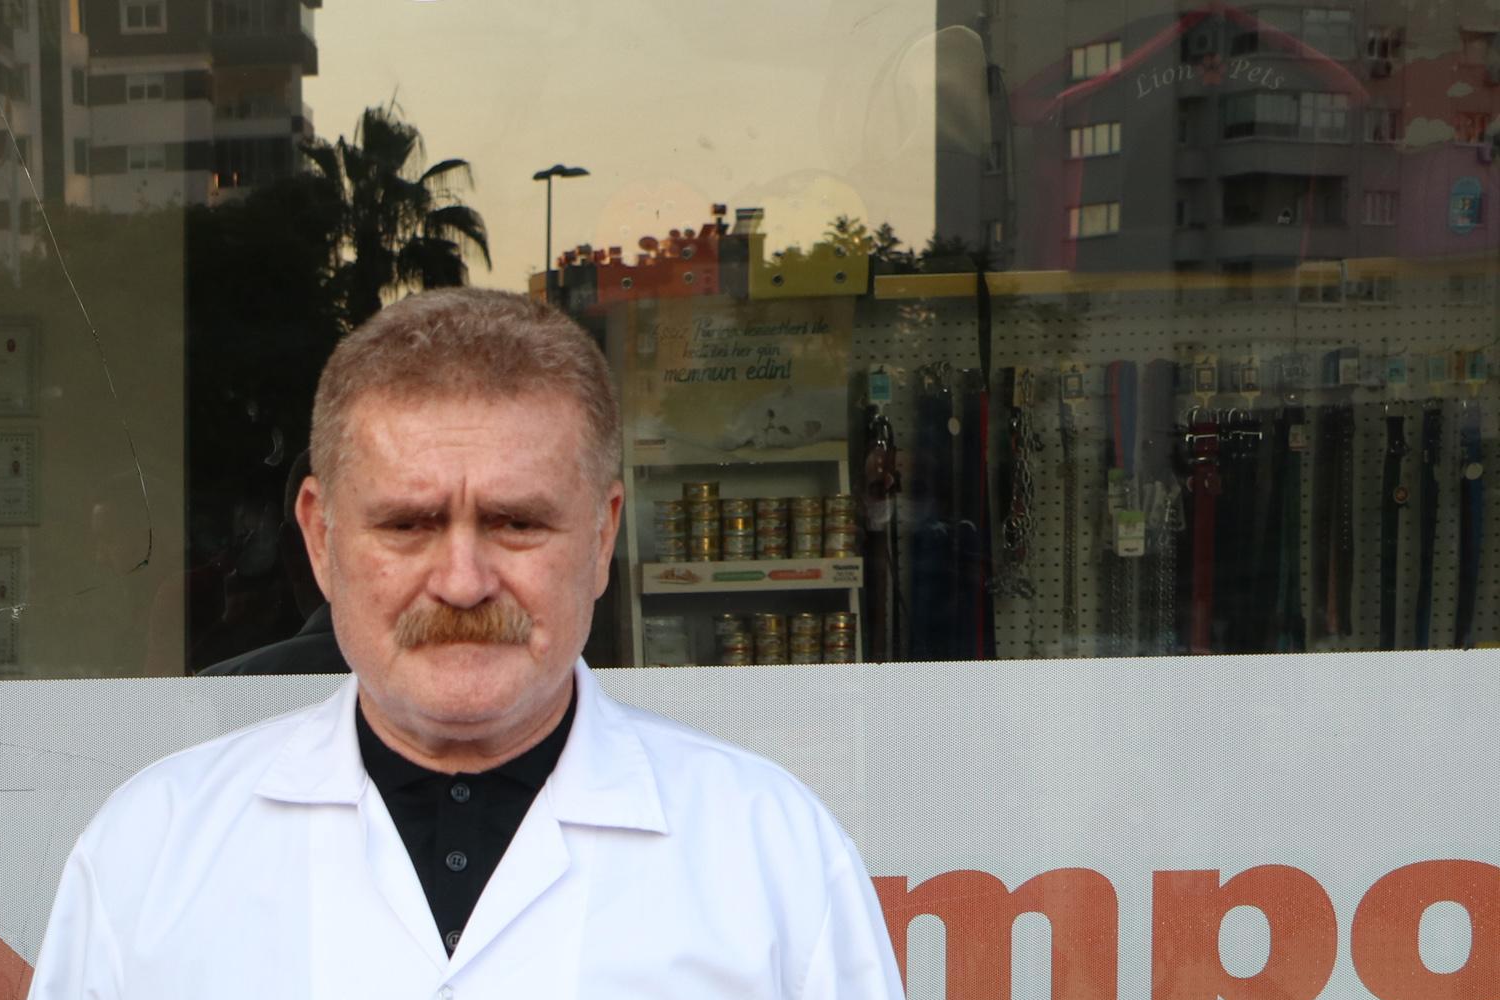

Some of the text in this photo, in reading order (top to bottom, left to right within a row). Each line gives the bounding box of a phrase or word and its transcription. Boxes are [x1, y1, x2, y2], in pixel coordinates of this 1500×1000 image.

[1136, 58, 1285, 98] Lion Pets
[663, 365, 736, 384] memnun
